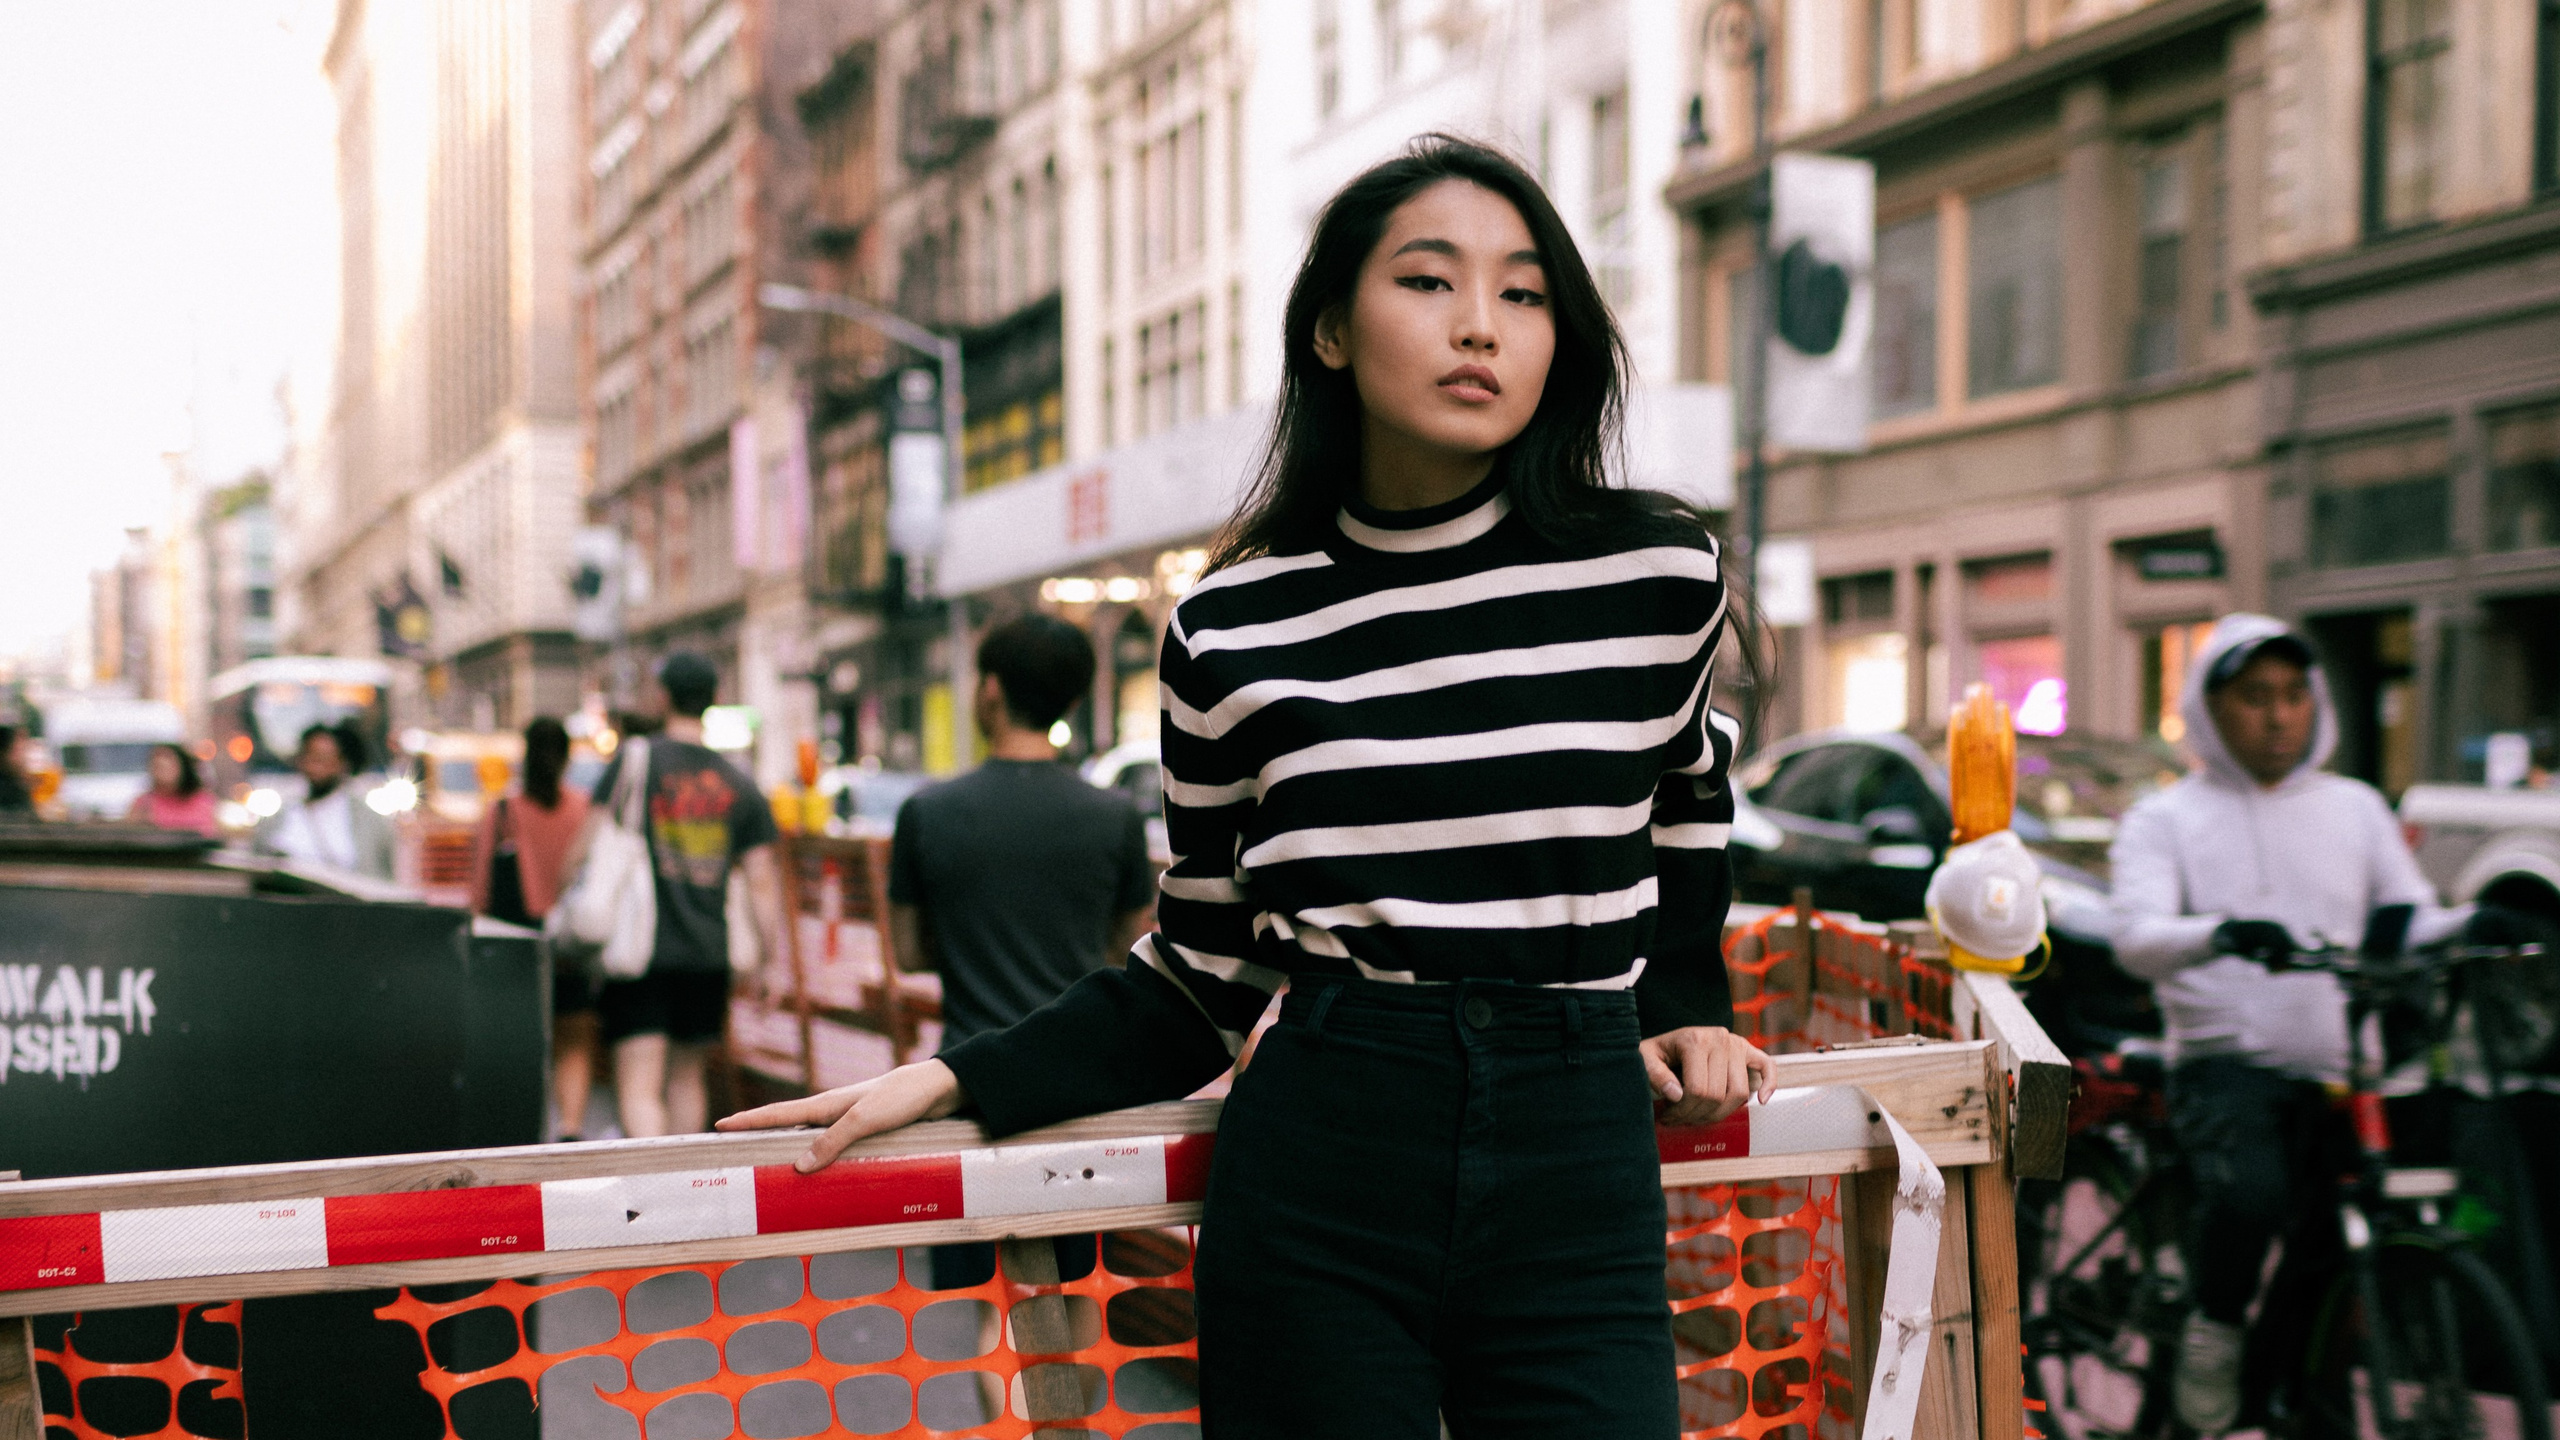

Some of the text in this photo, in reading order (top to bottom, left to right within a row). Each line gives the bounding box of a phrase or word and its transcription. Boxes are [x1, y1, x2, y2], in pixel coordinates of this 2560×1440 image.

[1105, 1147, 1139, 1156] DOT-C2
[1694, 1142, 1727, 1153] DOT-C2
[692, 1177, 727, 1188] DOT-C2
[259, 1208, 296, 1219] DOT-C2
[903, 1203, 938, 1214] DOT-C2
[481, 1235, 518, 1246] DOT-C2
[38, 1266, 77, 1278] DOT-C2
